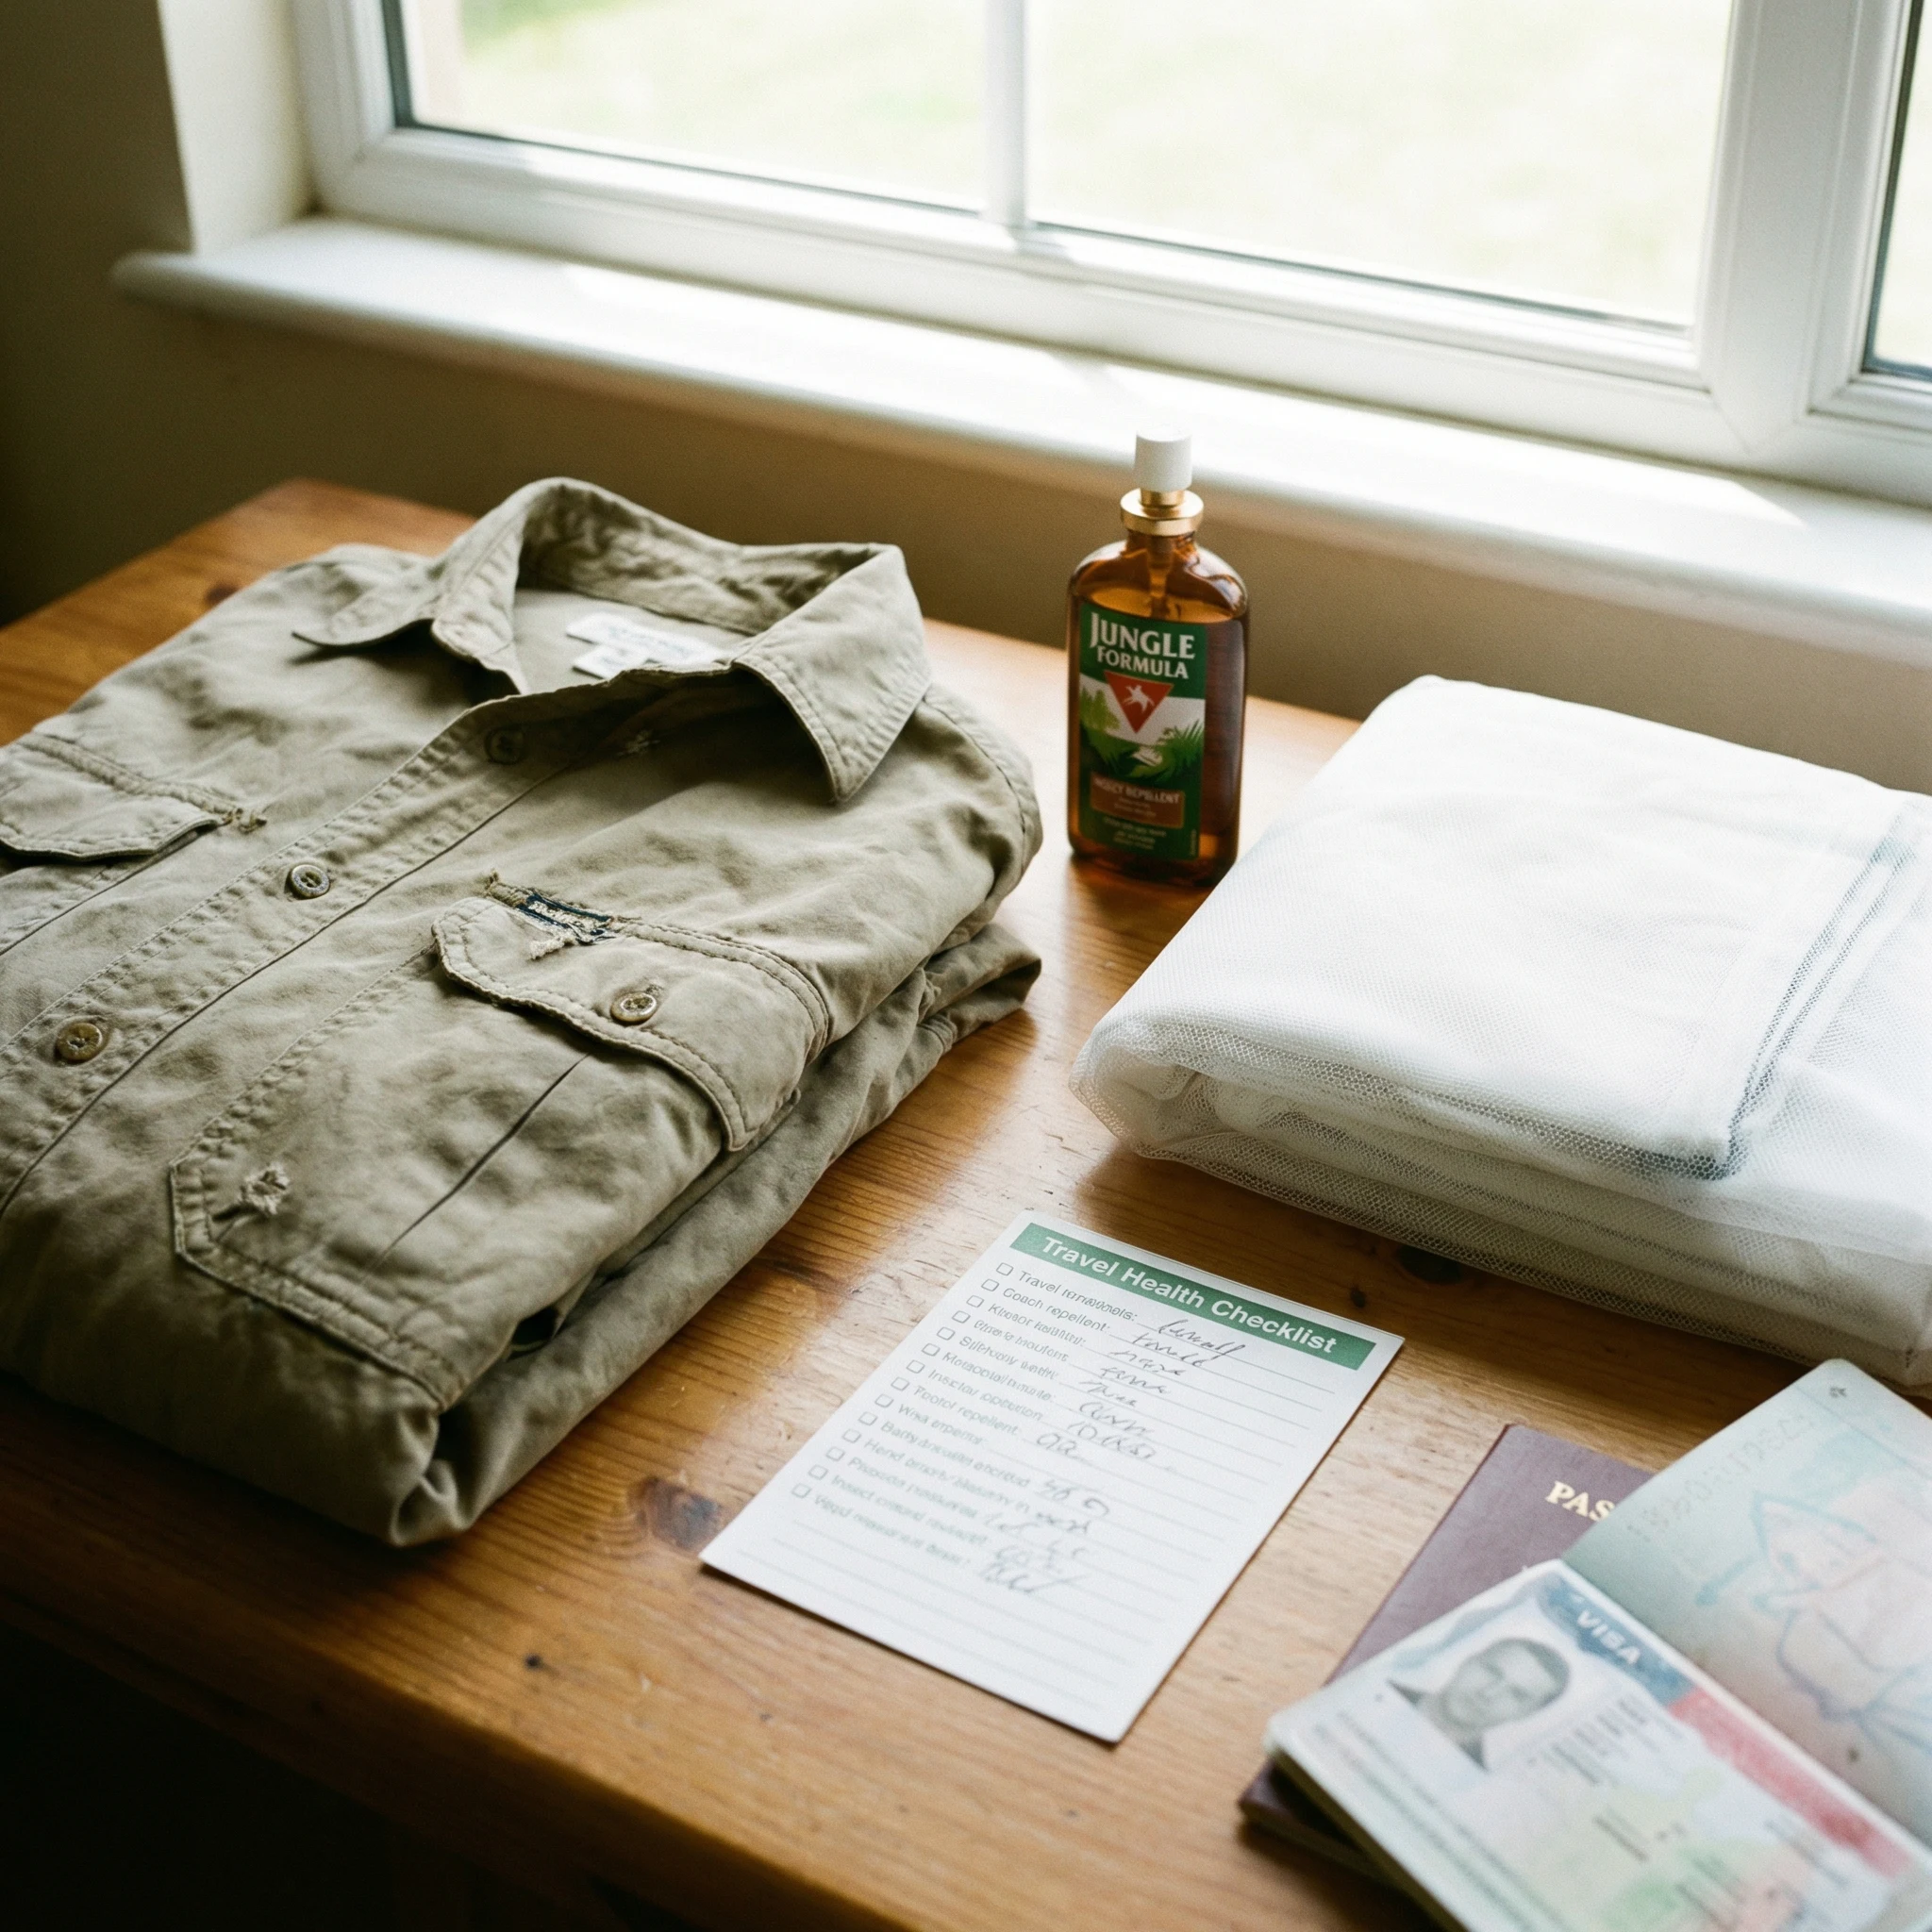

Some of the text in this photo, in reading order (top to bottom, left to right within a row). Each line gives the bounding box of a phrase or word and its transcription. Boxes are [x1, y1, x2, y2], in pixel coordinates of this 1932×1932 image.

[1091, 611, 1196, 659] JUNGLE
[1097, 645, 1189, 679] FORMULA
[1019, 1271, 1061, 1293] Travel
[1041, 1237, 1119, 1275] Travel
[1121, 1267, 1206, 1308] Health
[1211, 1299, 1338, 1354] Checklist
